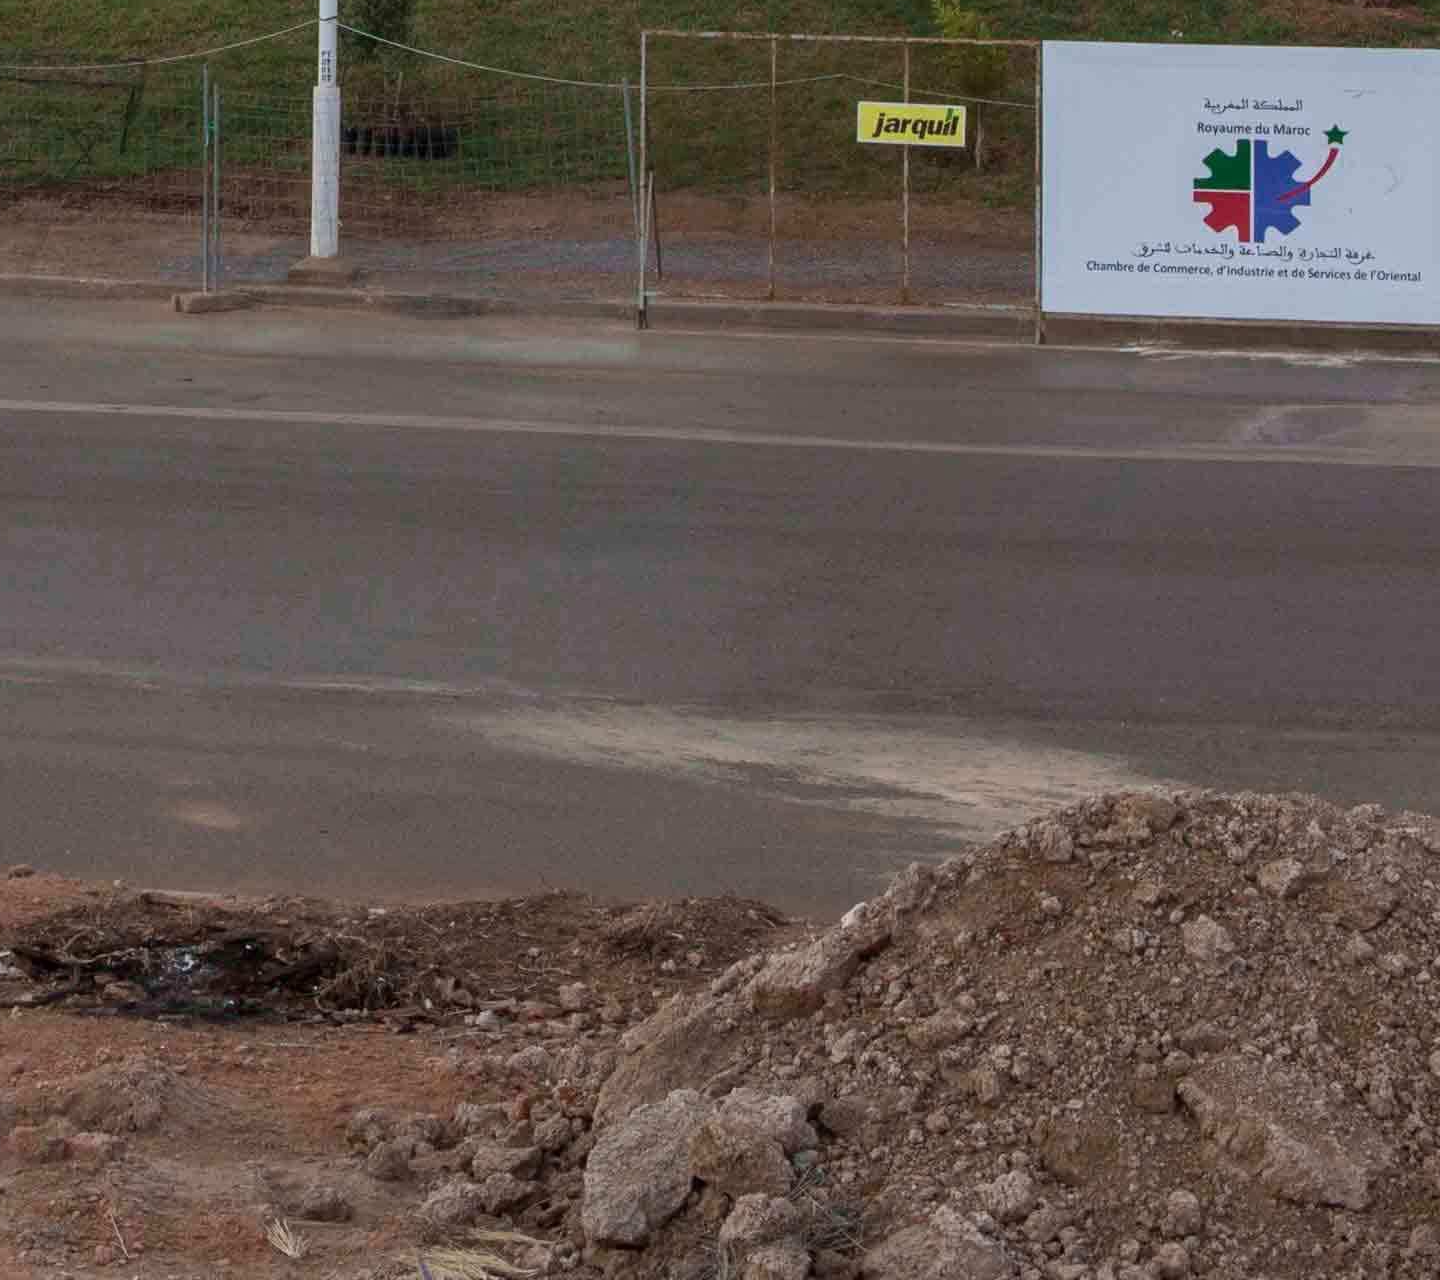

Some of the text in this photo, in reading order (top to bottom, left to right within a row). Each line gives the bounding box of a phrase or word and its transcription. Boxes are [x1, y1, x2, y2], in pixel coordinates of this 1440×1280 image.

[1204, 97, 1303, 114] المملكة المغربية
[872, 111, 959, 139] jarquil
[1197, 122, 1312, 136] Royaume du Maroc
[1175, 243, 1234, 260] والخدمات
[1239, 244, 1293, 262] والصناعة
[1299, 247, 1342, 261] التجارة
[1345, 249, 1376, 265] غرفة
[1086, 260, 1422, 282] Chambre de Commerce, d'Industrie et de Services de l'Oriental
